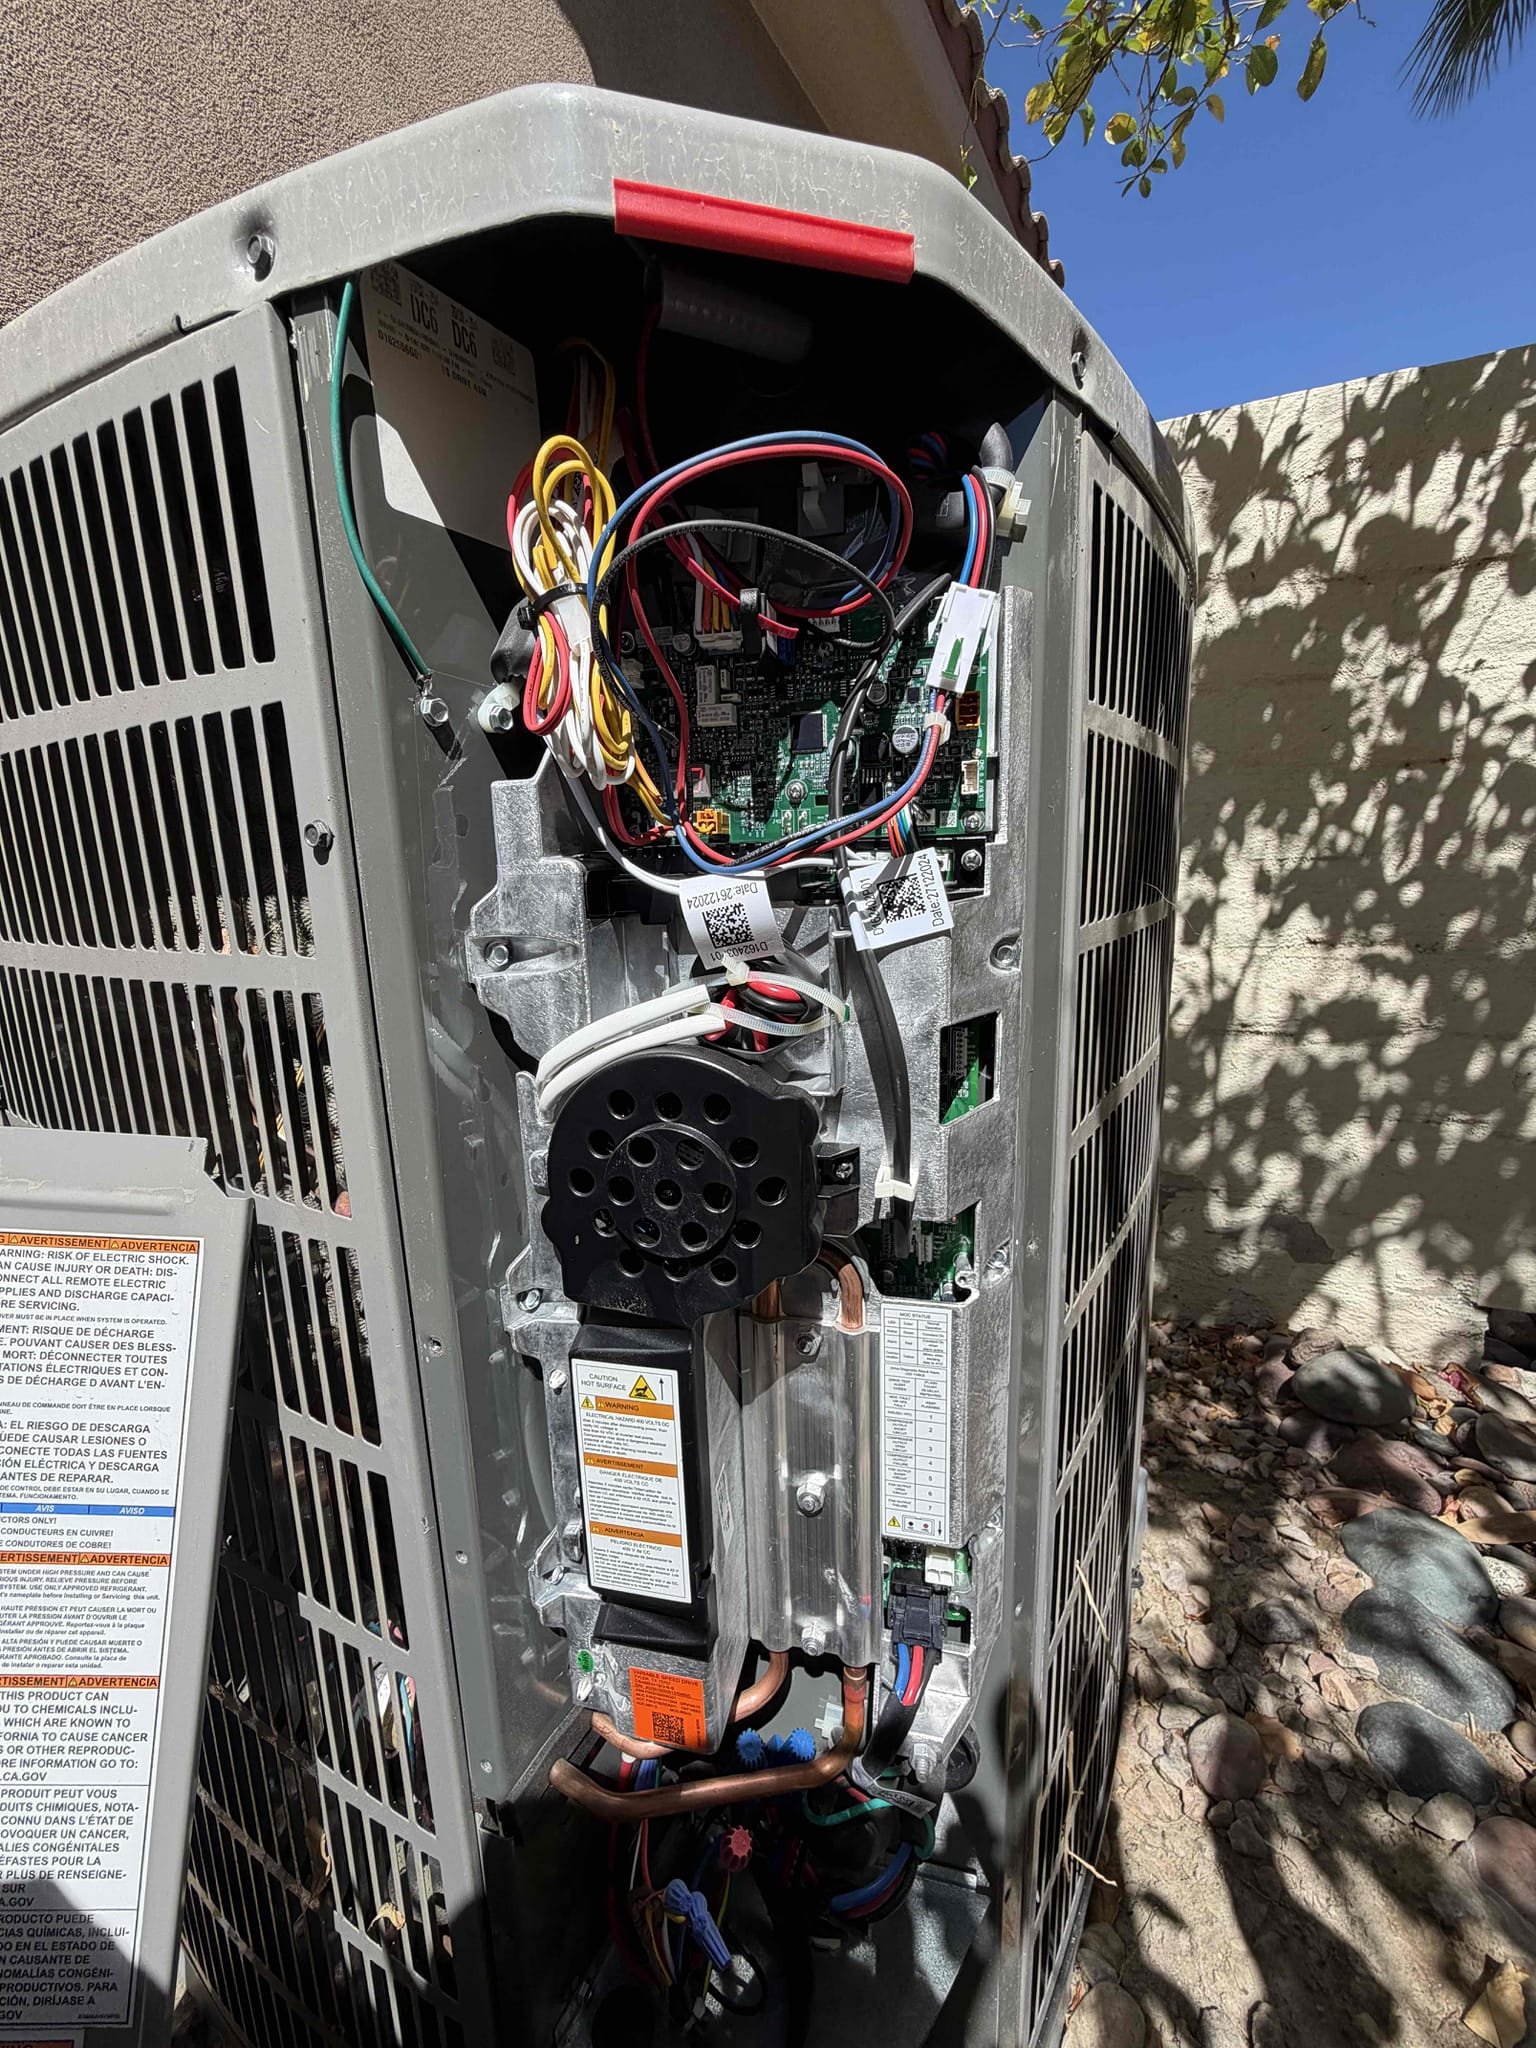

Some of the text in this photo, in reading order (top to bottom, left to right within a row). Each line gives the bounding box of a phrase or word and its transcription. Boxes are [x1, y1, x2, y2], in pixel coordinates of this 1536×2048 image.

[410, 294, 438, 335] DC6
[452, 318, 478, 359] DC6
[687, 881, 758, 910] Date:26122024
[922, 853, 945, 927] Date:27122024
[711, 941, 769, 962] D16240301
[19, 1237, 108, 1248] AVERTISSEMENT
[120, 1241, 196, 1252] ADVERTENCIA
[47, 1251, 73, 1260] RISK
[75, 1252, 90, 1261] OF
[93, 1253, 145, 1263] ELECTRIC
[148, 1255, 189, 1265] SHOCK.
[14, 1261, 52, 1272] CAUSE
[54, 1263, 93, 1274] INJURY
[95, 1265, 111, 1275] OR
[114, 1266, 153, 1276] DEATH:
[156, 1268, 178, 1278] DIS-
[41, 1276, 166, 1289] ALL REMOTE ELECTRIC
[38, 1288, 62, 1298] AND
[64, 1289, 128, 1301] DISCHARGE
[130, 1292, 175, 1302] CAPACI-
[18, 1300, 80, 1312] SERVICING.
[32, 1326, 74, 1336] RISQUE
[76, 1327, 91, 1337] DE
[93, 1326, 155, 1339] DÉCHARGE
[10, 1338, 176, 1352] POUVANT CAUSER DES BLESS-
[2, 1350, 168, 1364] MORT: DÉCONNECTER TOUTES
[45, 1362, 122, 1375] ÉLECTRIQUES
[124, 1366, 140, 1376] ET
[140, 1367, 169, 1376] CON-
[7, 1375, 23, 1385] DE
[25, 1374, 88, 1387] DÉCHARGE
[98, 1378, 137, 1388] AVANT
[137, 1379, 166, 1389] L'EN-
[589, 1373, 618, 1382] CAUTION
[595, 1381, 627, 1391] SURFACE
[605, 1401, 640, 1412] WARNING
[10, 1421, 150, 1434] EL RIESGO DE DESCARGA
[32, 1434, 146, 1446] CAUSAR LESIONES O
[53, 1448, 91, 1458] TODAS
[93, 1449, 115, 1458] LAS
[118, 1449, 168, 1460] FUENTES
[24, 1458, 159, 1472] ELÉCTRICA Y DESCARGA
[596, 1458, 644, 1469] AVERTISSEMENT
[0, 1472, 114, 1484] ANTES DE REPARAR.
[0, 1528, 65, 1536] CONDUCTEURS
[604, 1527, 645, 1537] ADVERTENCIA
[5, 1540, 64, 1548] CONDUTORES
[90, 1555, 168, 1564] ADVERTENCIA
[78, 1678, 157, 1686] ADVERTENCIA
[0, 1691, 109, 1701] THIS PRODUCT CAN
[12, 1705, 138, 1714] TO CHEMICALS INCLU-
[3, 1718, 131, 1728] WHICH ARE KNOWN TO
[42, 1732, 57, 1742] TO
[60, 1732, 99, 1742] CAUSE
[101, 1733, 148, 1742] CANCER
[6, 1746, 135, 1755] OR OTHER REPRODUC-
[19, 1759, 138, 1768] INFORMATION GO TO:
[0, 1789, 117, 1798] PRODUIT PEUT VOUS
[35, 1803, 102, 1813] CHIMIQUES,
[104, 1803, 139, 1812] NOTA-
[0, 1814, 134, 1825] CONNU DANS L'ÉTAT DE
[60, 1830, 76, 1839] UN
[79, 1830, 129, 1840] CANCER,
[32, 1841, 120, 1852] CONGÉNITALES
[51, 1856, 84, 1865] POUR
[86, 1856, 101, 1865] LA
[6, 1870, 126, 1879] PLUS DE RENSEIGNE-
[2, 1884, 26, 1893] SUR
[55, 1914, 94, 1923] PUEDE
[27, 1926, 86, 1938] QUÍMICAS,
[15, 1941, 116, 1950] EN EL ESTADO DE
[8, 1955, 90, 1964] CAUSANTE DE
[58, 1967, 114, 1978] CONGÉNI-
[87, 1983, 118, 1992] PARA
[32, 1994, 85, 2005] DIRÍJASE
[86, 1996, 96, 2005] A
